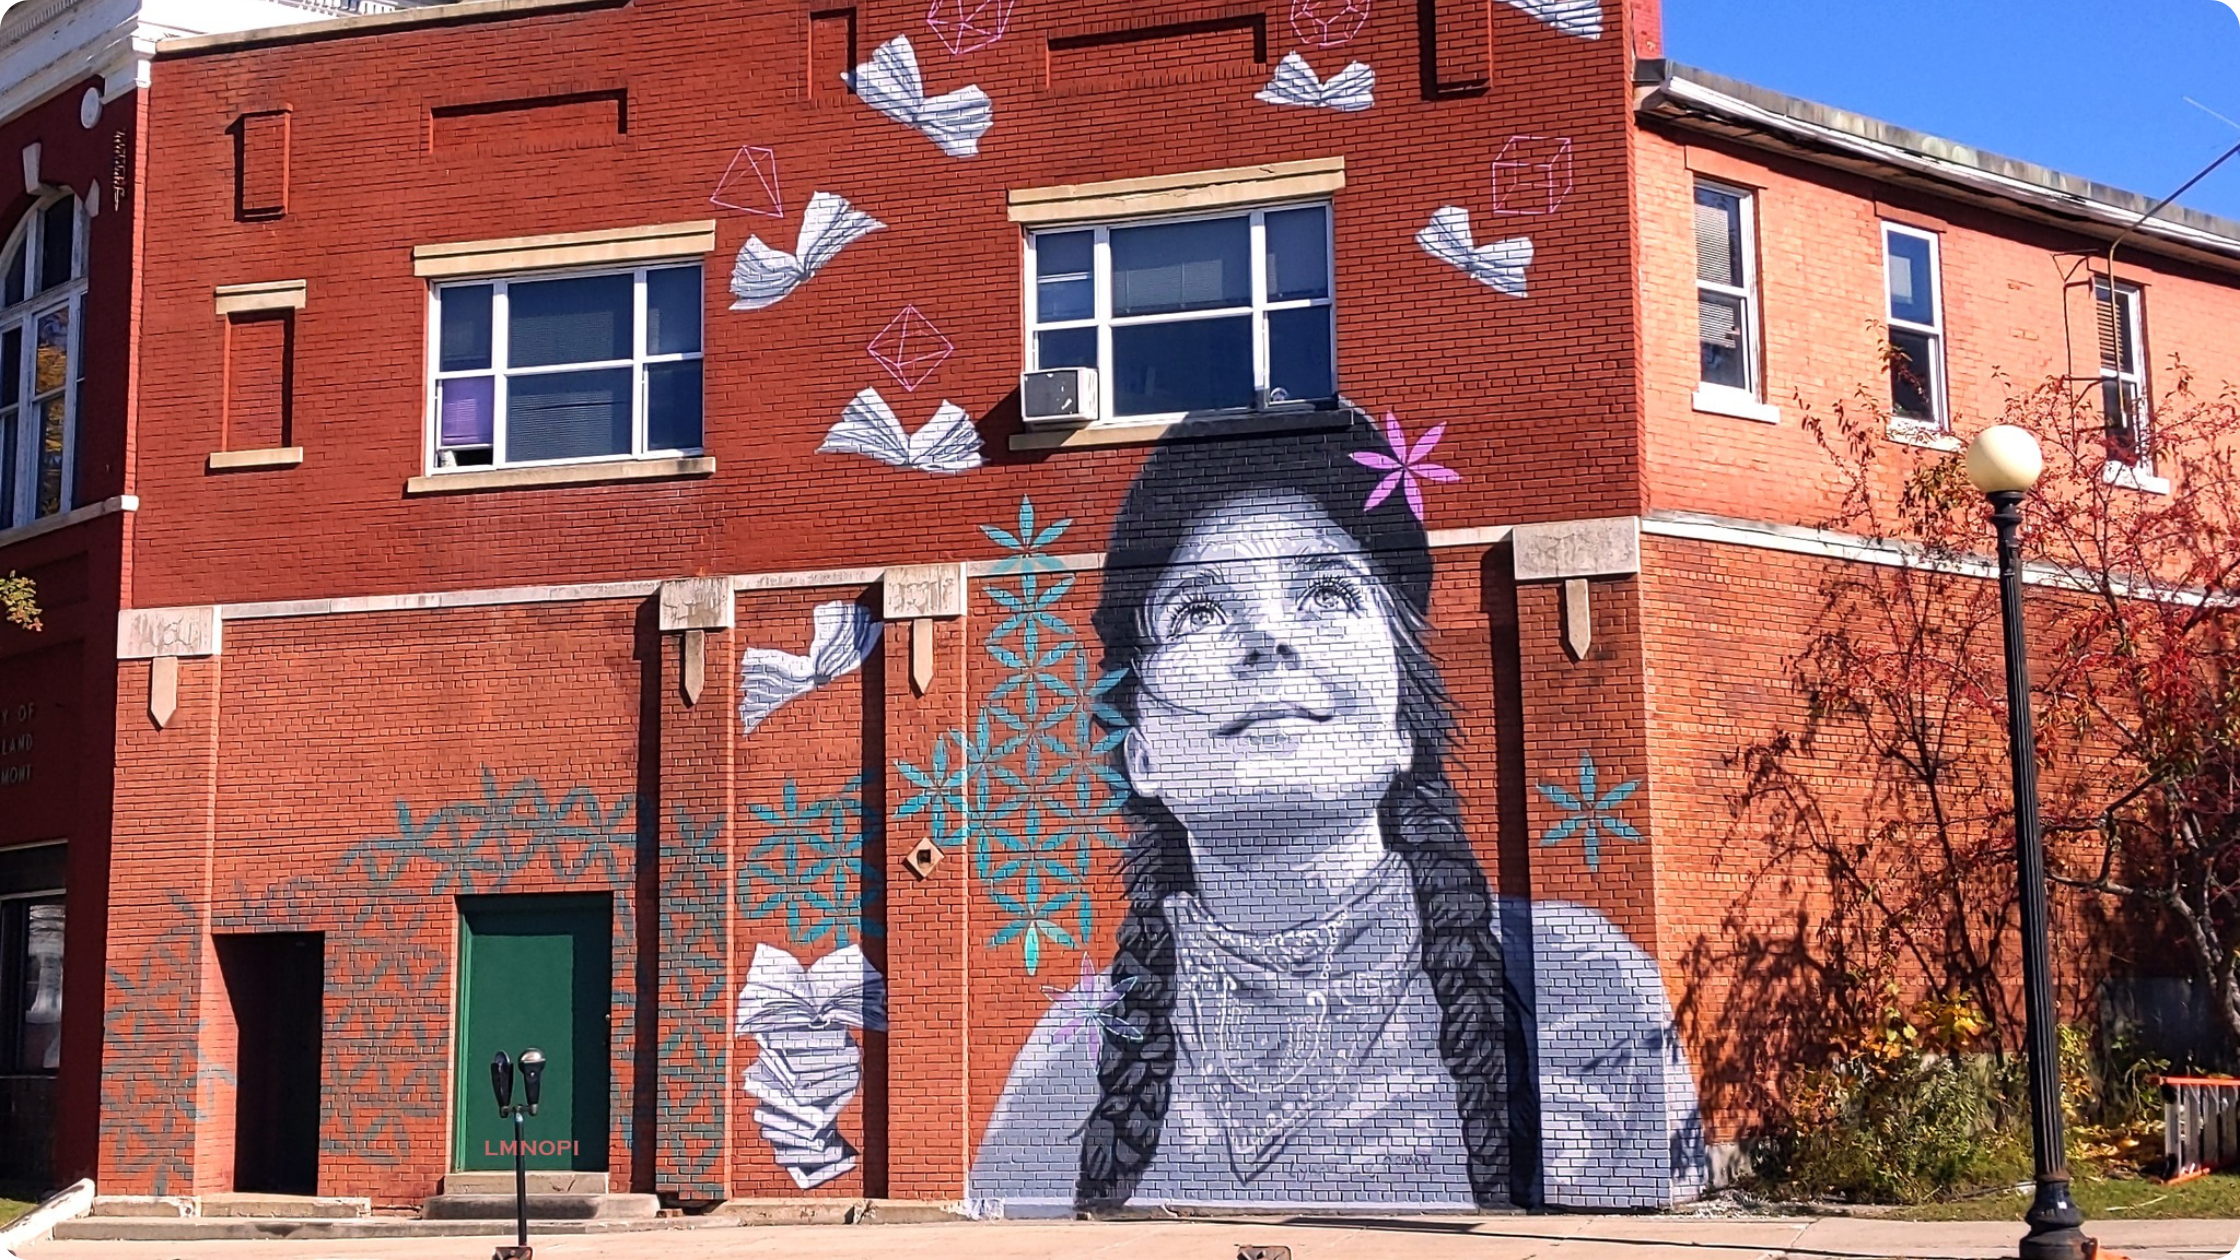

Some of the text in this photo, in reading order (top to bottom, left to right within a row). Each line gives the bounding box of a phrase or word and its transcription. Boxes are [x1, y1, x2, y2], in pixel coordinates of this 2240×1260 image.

[18, 702, 34, 722] OF
[1, 733, 33, 755] LAND
[0, 764, 31, 785] MONT
